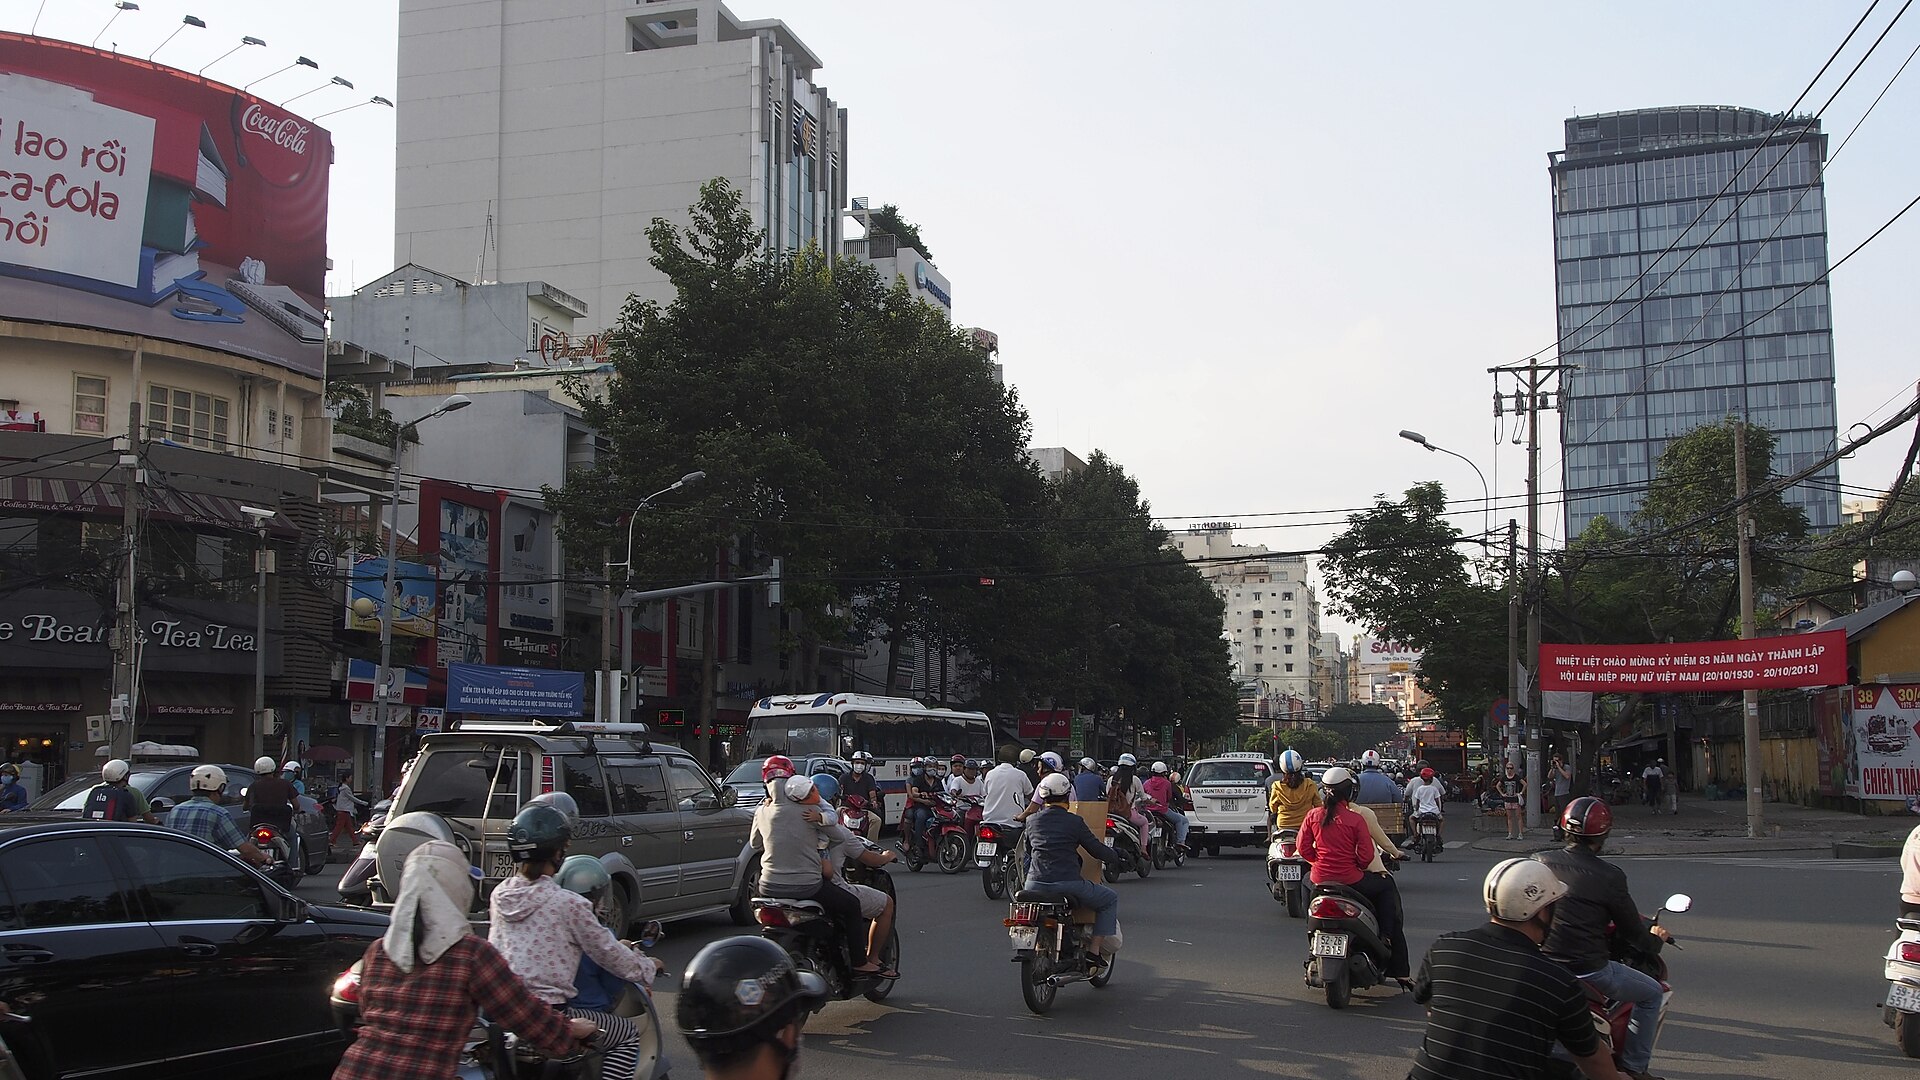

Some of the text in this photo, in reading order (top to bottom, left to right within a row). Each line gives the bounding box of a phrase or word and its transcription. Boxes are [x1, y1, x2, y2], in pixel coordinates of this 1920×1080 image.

[242, 104, 310, 155] Coca-Cola
[15, 120, 68, 160] lao
[81, 140, 126, 176] rồi
[151, 620, 201, 649] Tea
[206, 623, 259, 651] Lea
[1555, 654, 1580, 667] NHIỆT
[1583, 655, 1600, 667] LIỆT
[1603, 655, 1627, 666] CHÀO
[1630, 655, 1655, 666] MỪNG
[1674, 654, 1697, 667] NIỆM
[1699, 656, 1710, 665] 83
[1713, 652, 1734, 664] NĂM
[1737, 650, 1764, 663] NGÀY
[1767, 647, 1802, 660] THÀNH
[1805, 644, 1825, 658] LẬP
[1560, 670, 1574, 682] HỘI
[1577, 670, 1595, 682] LIÊN
[1598, 670, 1617, 683] HIỆP
[1620, 672, 1638, 683] PHỤ
[1656, 671, 1677, 683] VIỆT
[1679, 672, 1699, 681] NAM
[1702, 670, 1754, 682] (20/10/1930
[1763, 664, 1819, 678] 20/10/2013)
[1858, 689, 1874, 704] 38
[420, 715, 439, 728] 24
[1863, 762, 1894, 795] CHIẾN
